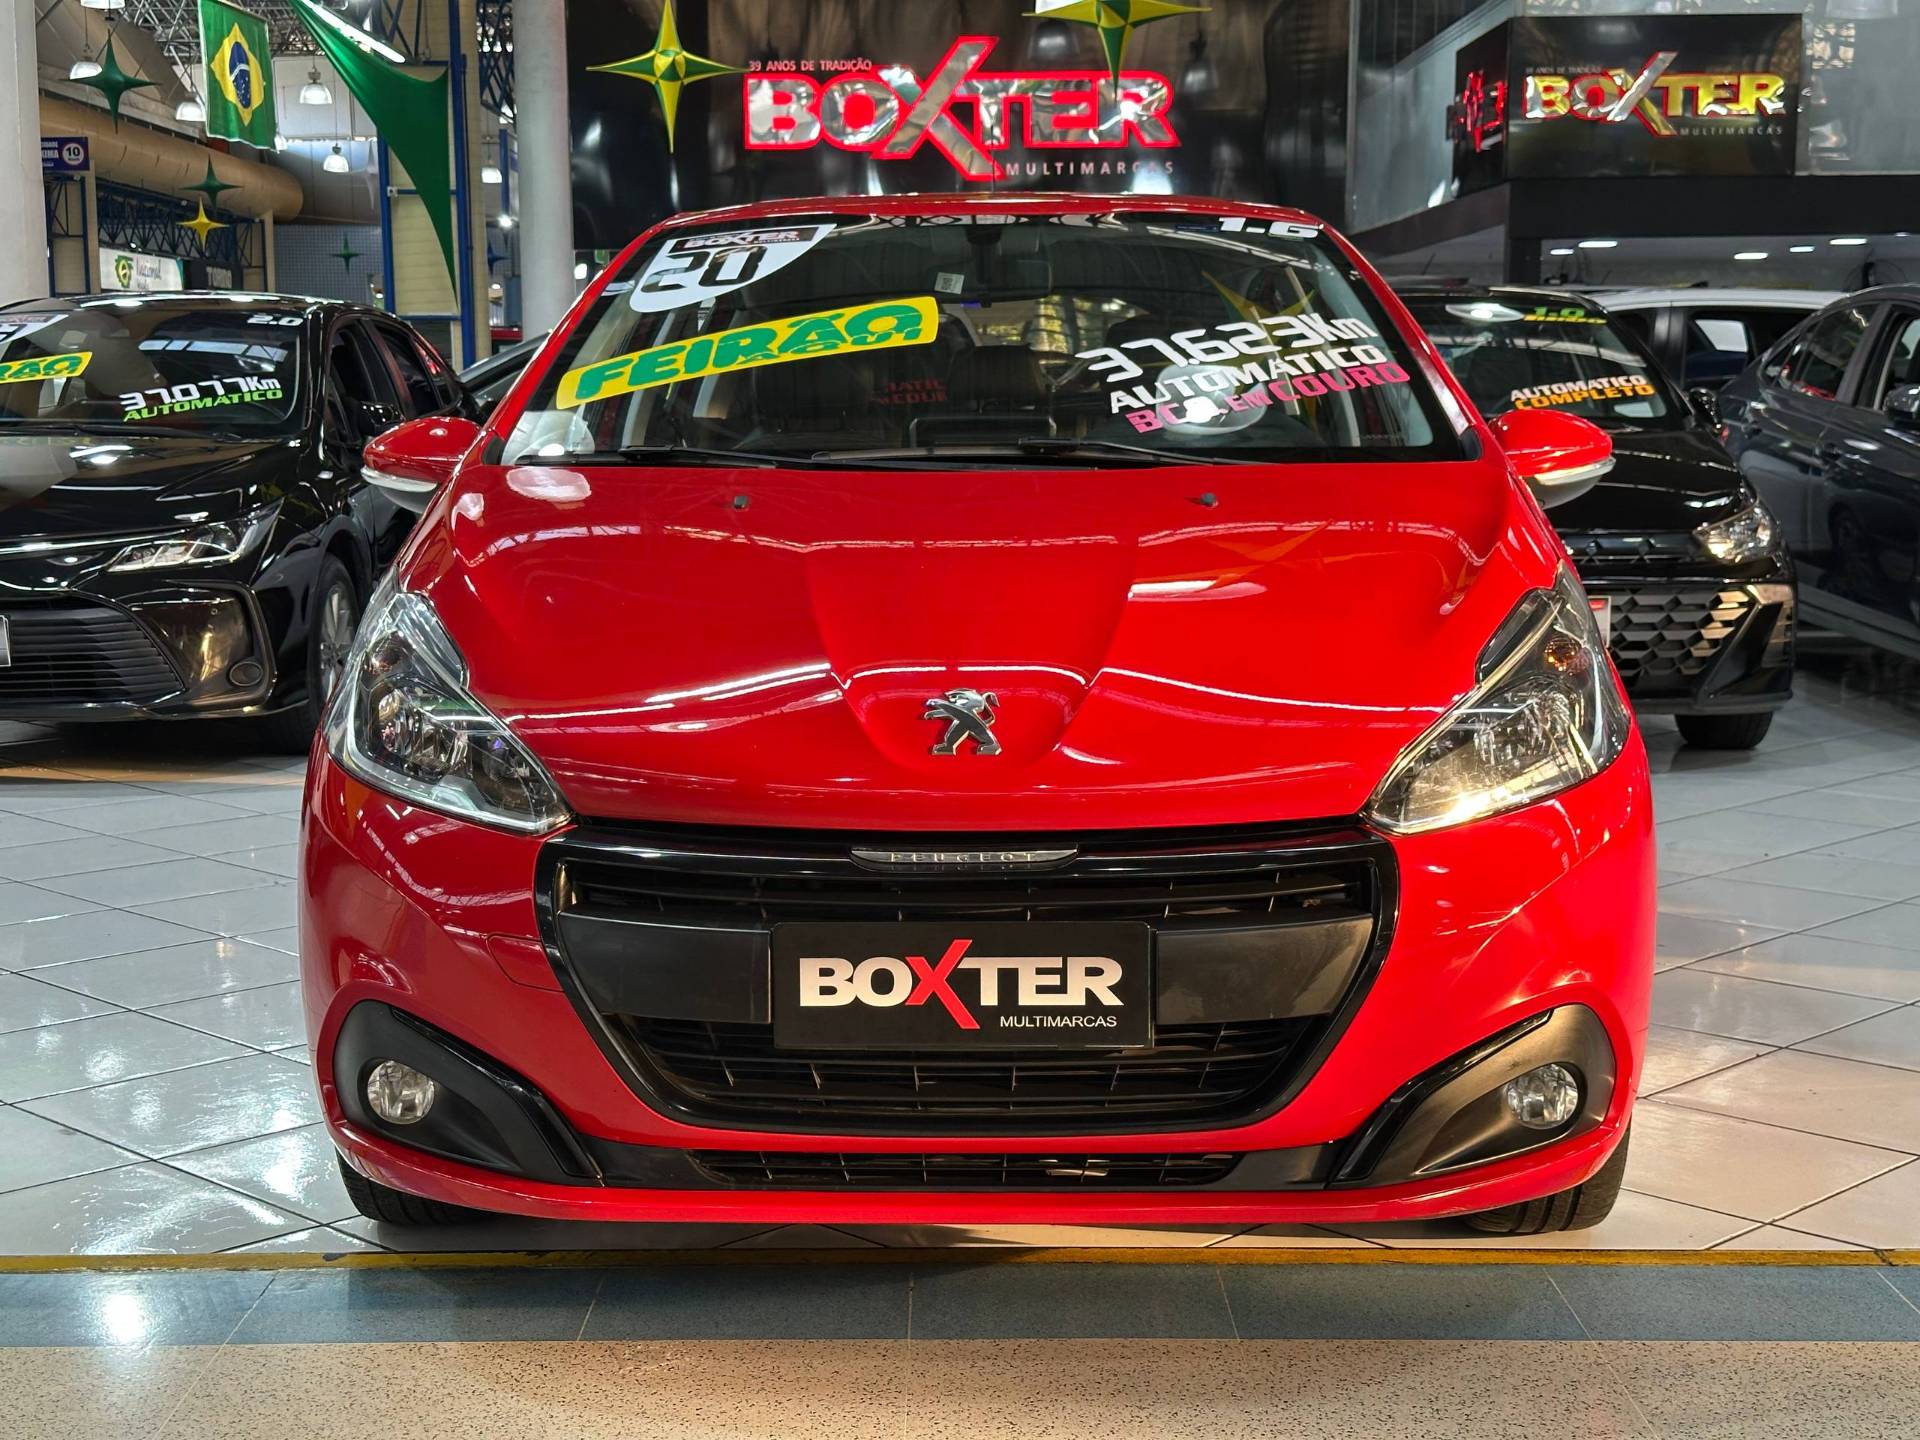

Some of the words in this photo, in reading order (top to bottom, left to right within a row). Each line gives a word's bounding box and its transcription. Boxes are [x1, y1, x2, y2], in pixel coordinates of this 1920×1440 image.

[749, 61, 761, 71] 39
[766, 61, 796, 71] ANOS
[801, 61, 815, 71] DE
[820, 57, 872, 72] TRADIÇÃO
[1522, 51, 1785, 137] BOXTER
[743, 35, 1181, 181] BOXTER
[1680, 126, 1783, 136] MULTIMARCAS
[65, 146, 80, 157] 10
[1006, 161, 1173, 175] MULTIMARCAS
[684, 231, 799, 248] BOXTER
[1219, 217, 1318, 238] 1.6
[640, 245, 768, 293] 20
[247, 314, 304, 326] 2.0
[1534, 307, 1585, 318] 1.0
[575, 304, 924, 400] FEIRÃO
[1074, 313, 1378, 382] 37.623Km
[1110, 344, 1388, 414] AUTOMATICO
[1224, 389, 1274, 412] EM
[1267, 361, 1410, 402] COURO
[1511, 375, 1649, 402] AUTOMATICO
[119, 376, 281, 411] 37.077Km
[123, 389, 283, 422] AUTOMATICO
[1515, 384, 1656, 410] COMPLETO
[890, 852, 1037, 863] PEUGEOT
[800, 939, 1124, 1029] BOXTER
[1000, 1015, 1117, 1027] MULTIMARCAS
